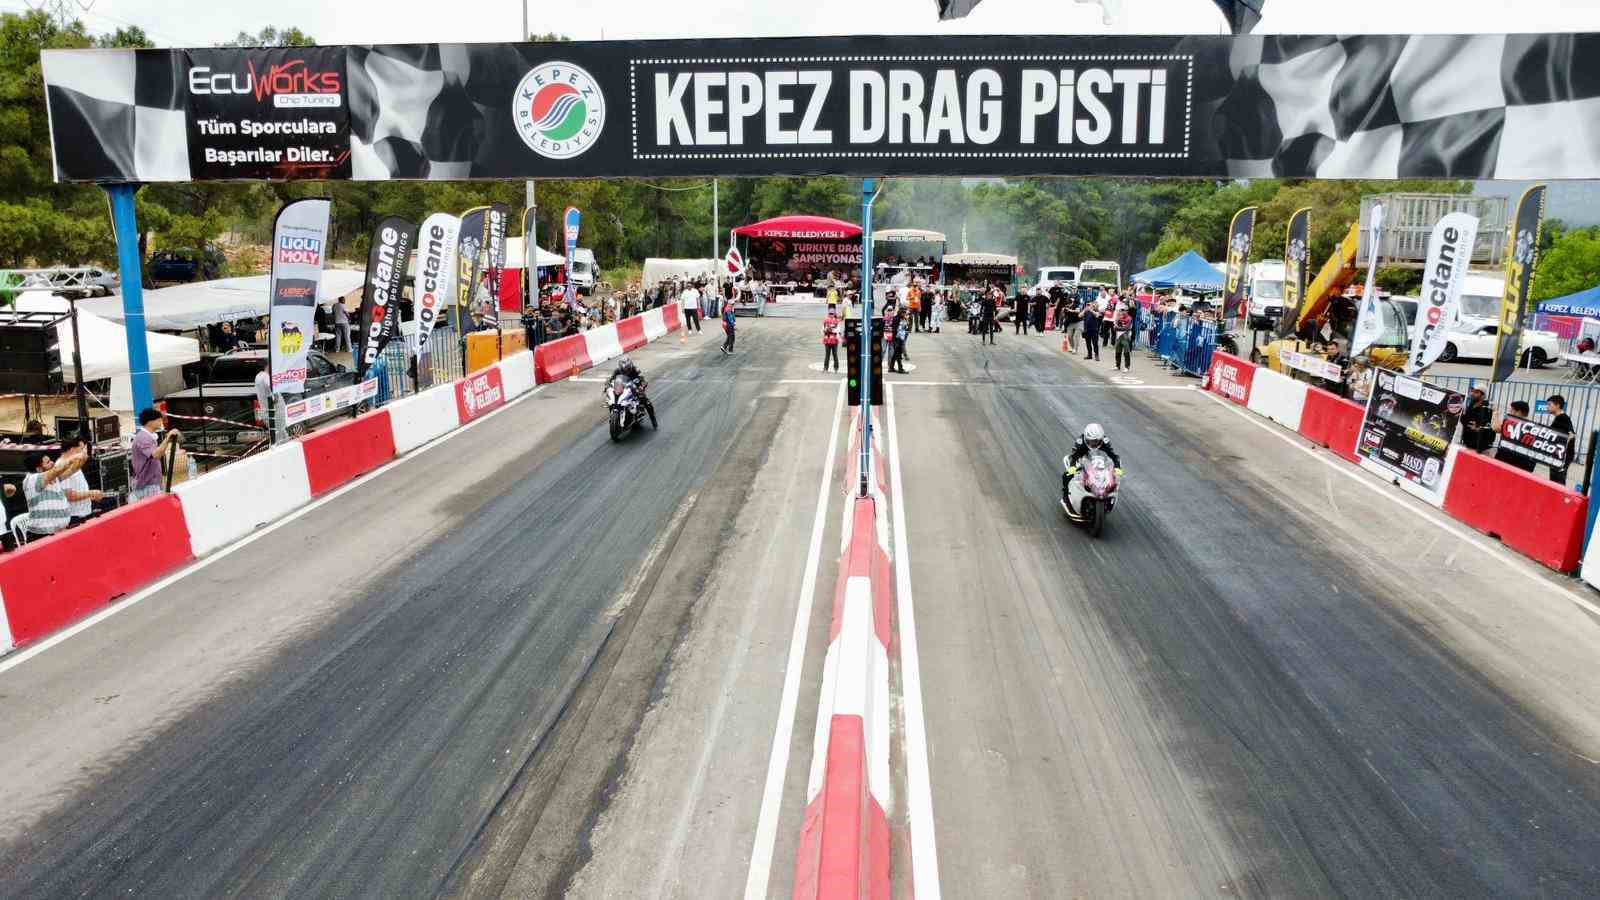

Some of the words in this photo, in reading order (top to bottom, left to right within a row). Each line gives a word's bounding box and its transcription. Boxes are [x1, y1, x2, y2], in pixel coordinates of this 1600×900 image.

[522, 70, 593, 100] KEPEZ
[655, 70, 832, 145] KEPEZ
[849, 69, 1003, 144] DRAG
[197, 120, 237, 135] Tüm
[240, 119, 337, 138] Sporculara
[204, 147, 282, 166] Başarılar
[286, 146, 335, 163] Diler.
[282, 237, 319, 252] LIQUI
[281, 251, 319, 266] MOLY
[390, 232, 408, 301] performance
